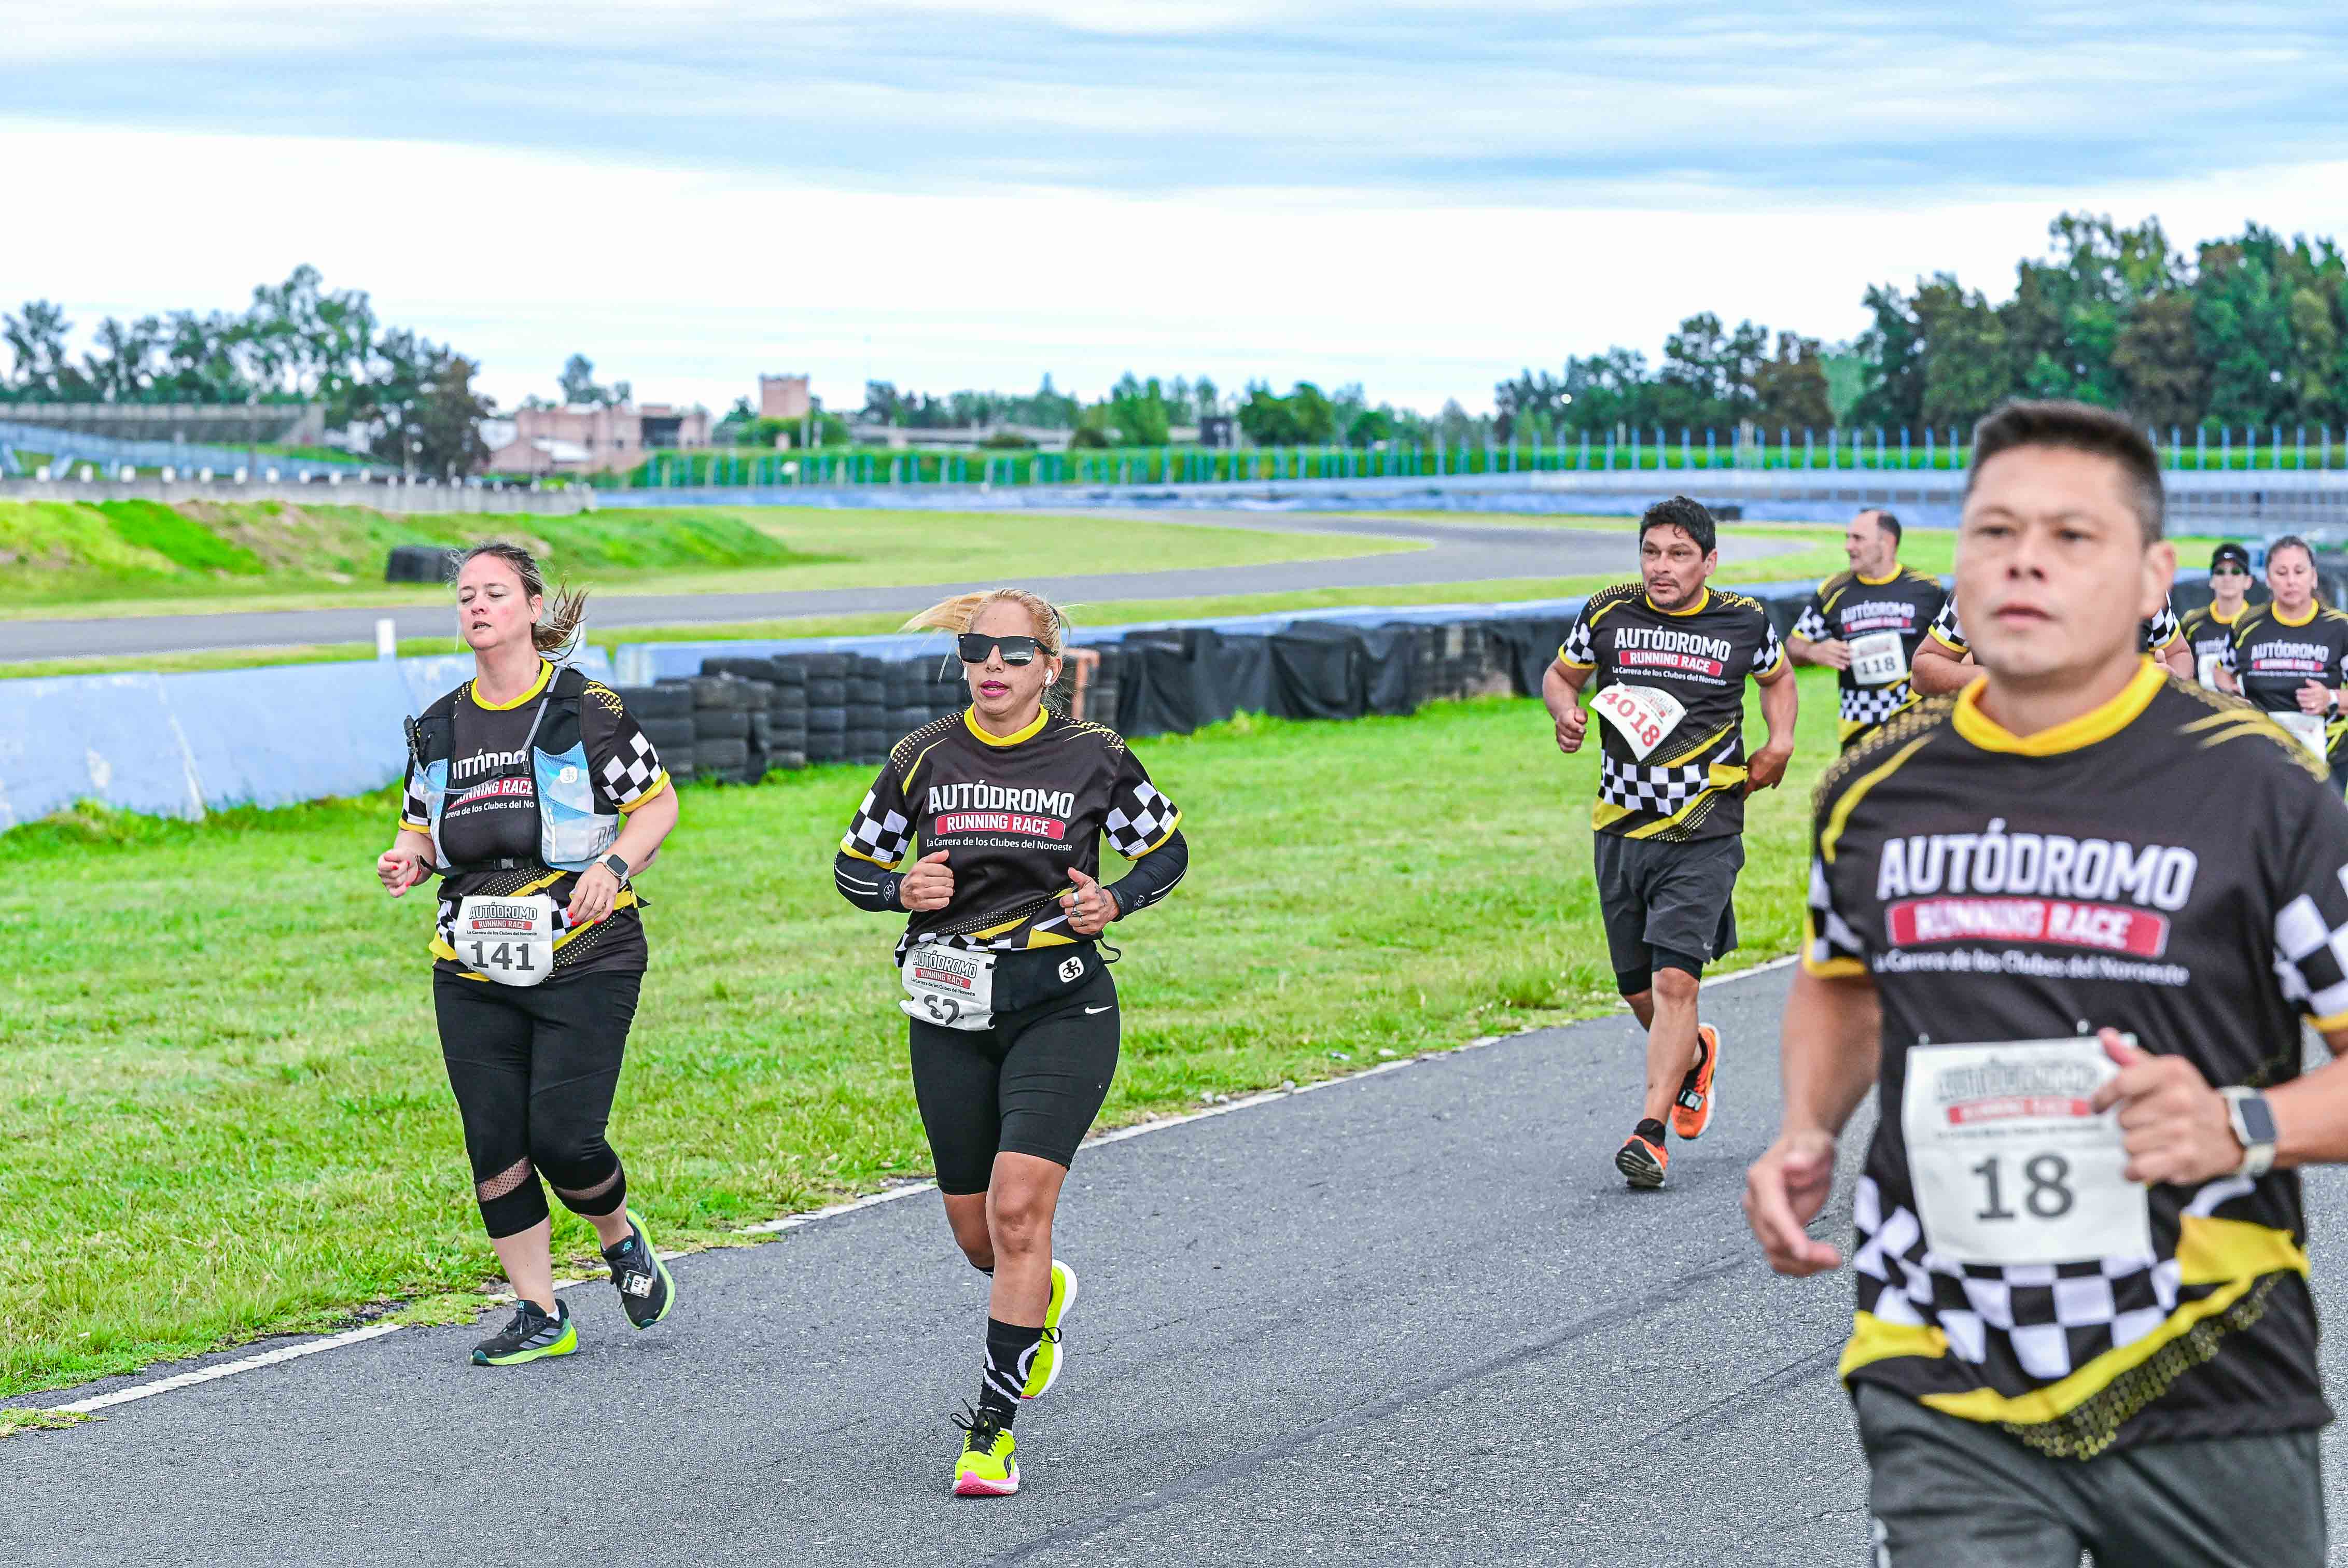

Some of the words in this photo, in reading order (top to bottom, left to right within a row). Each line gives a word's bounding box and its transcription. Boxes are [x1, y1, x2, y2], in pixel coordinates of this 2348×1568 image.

[1614, 625, 1731, 662] AUTÓDROMO
[2251, 639, 2329, 662] AUTÓDROMO
[1630, 652, 1678, 665] RUNNING
[1680, 656, 1711, 673] RACE
[1861, 656, 1896, 675] 118
[1619, 666, 1641, 675] Carrera
[1664, 670, 1686, 679] Clubes
[1687, 673, 1698, 681] del
[1601, 693, 1660, 747] 4018
[501, 779, 533, 795] RACE
[461, 806, 471, 815] de
[472, 804, 483, 813] los
[483, 802, 508, 811] Clubes
[508, 800, 521, 809] del
[928, 779, 1075, 819] AUTÓDROMO
[946, 814, 1009, 831] RUNNING
[1012, 817, 1050, 835] RACE
[927, 838, 933, 847] La
[934, 837, 961, 846] Carrera
[962, 837, 974, 846] de
[975, 837, 988, 846] los
[990, 838, 1020, 848] Clubes
[1021, 839, 1035, 849] del
[1037, 841, 1073, 851] Noroeste
[1876, 817, 2198, 912] AUTÓDROMO
[469, 902, 537, 920] AUTÓDROMO
[478, 920, 507, 928] RUNNING
[508, 920, 525, 929] RACE
[2047, 904, 2133, 949] RACE
[471, 941, 535, 971] 141
[913, 950, 977, 978] AUTÓDROMO
[920, 970, 945, 981] RUNNING
[947, 975, 963, 987] RACE
[1972, 1154, 2074, 1221] 18
